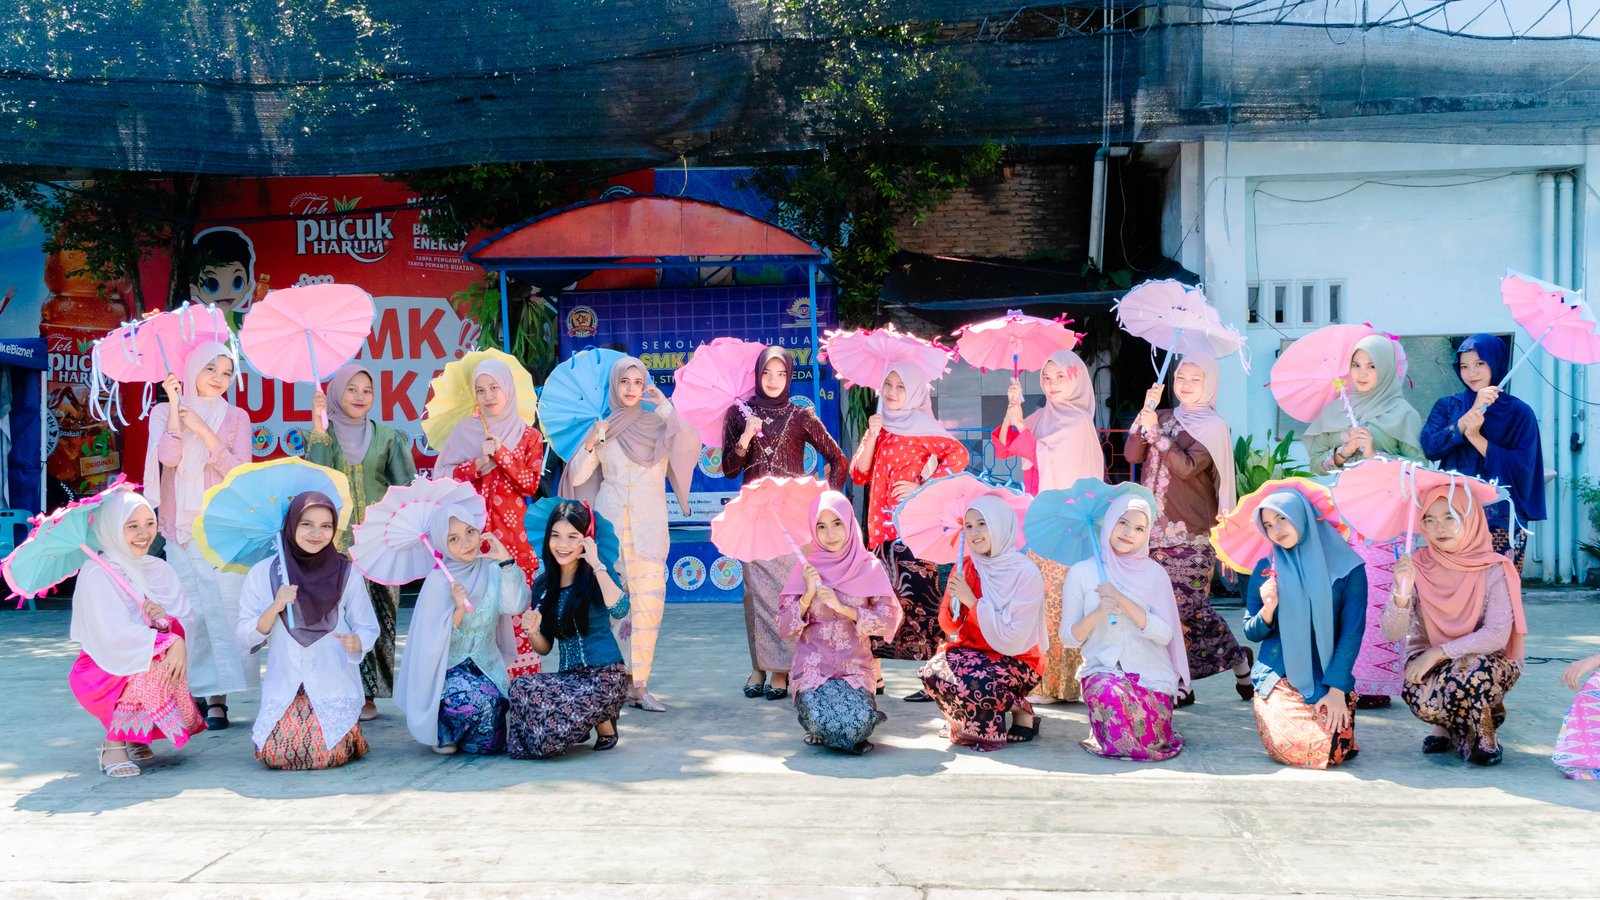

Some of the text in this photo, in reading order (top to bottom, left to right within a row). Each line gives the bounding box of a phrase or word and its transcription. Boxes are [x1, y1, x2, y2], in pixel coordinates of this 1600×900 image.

[294, 196, 329, 216] Teh
[296, 212, 394, 255] pucuk
[313, 240, 391, 261] HARUM
[47, 336, 73, 352] Teh
[354, 308, 447, 360] MK
[85, 458, 115, 469] ORIGINAL
